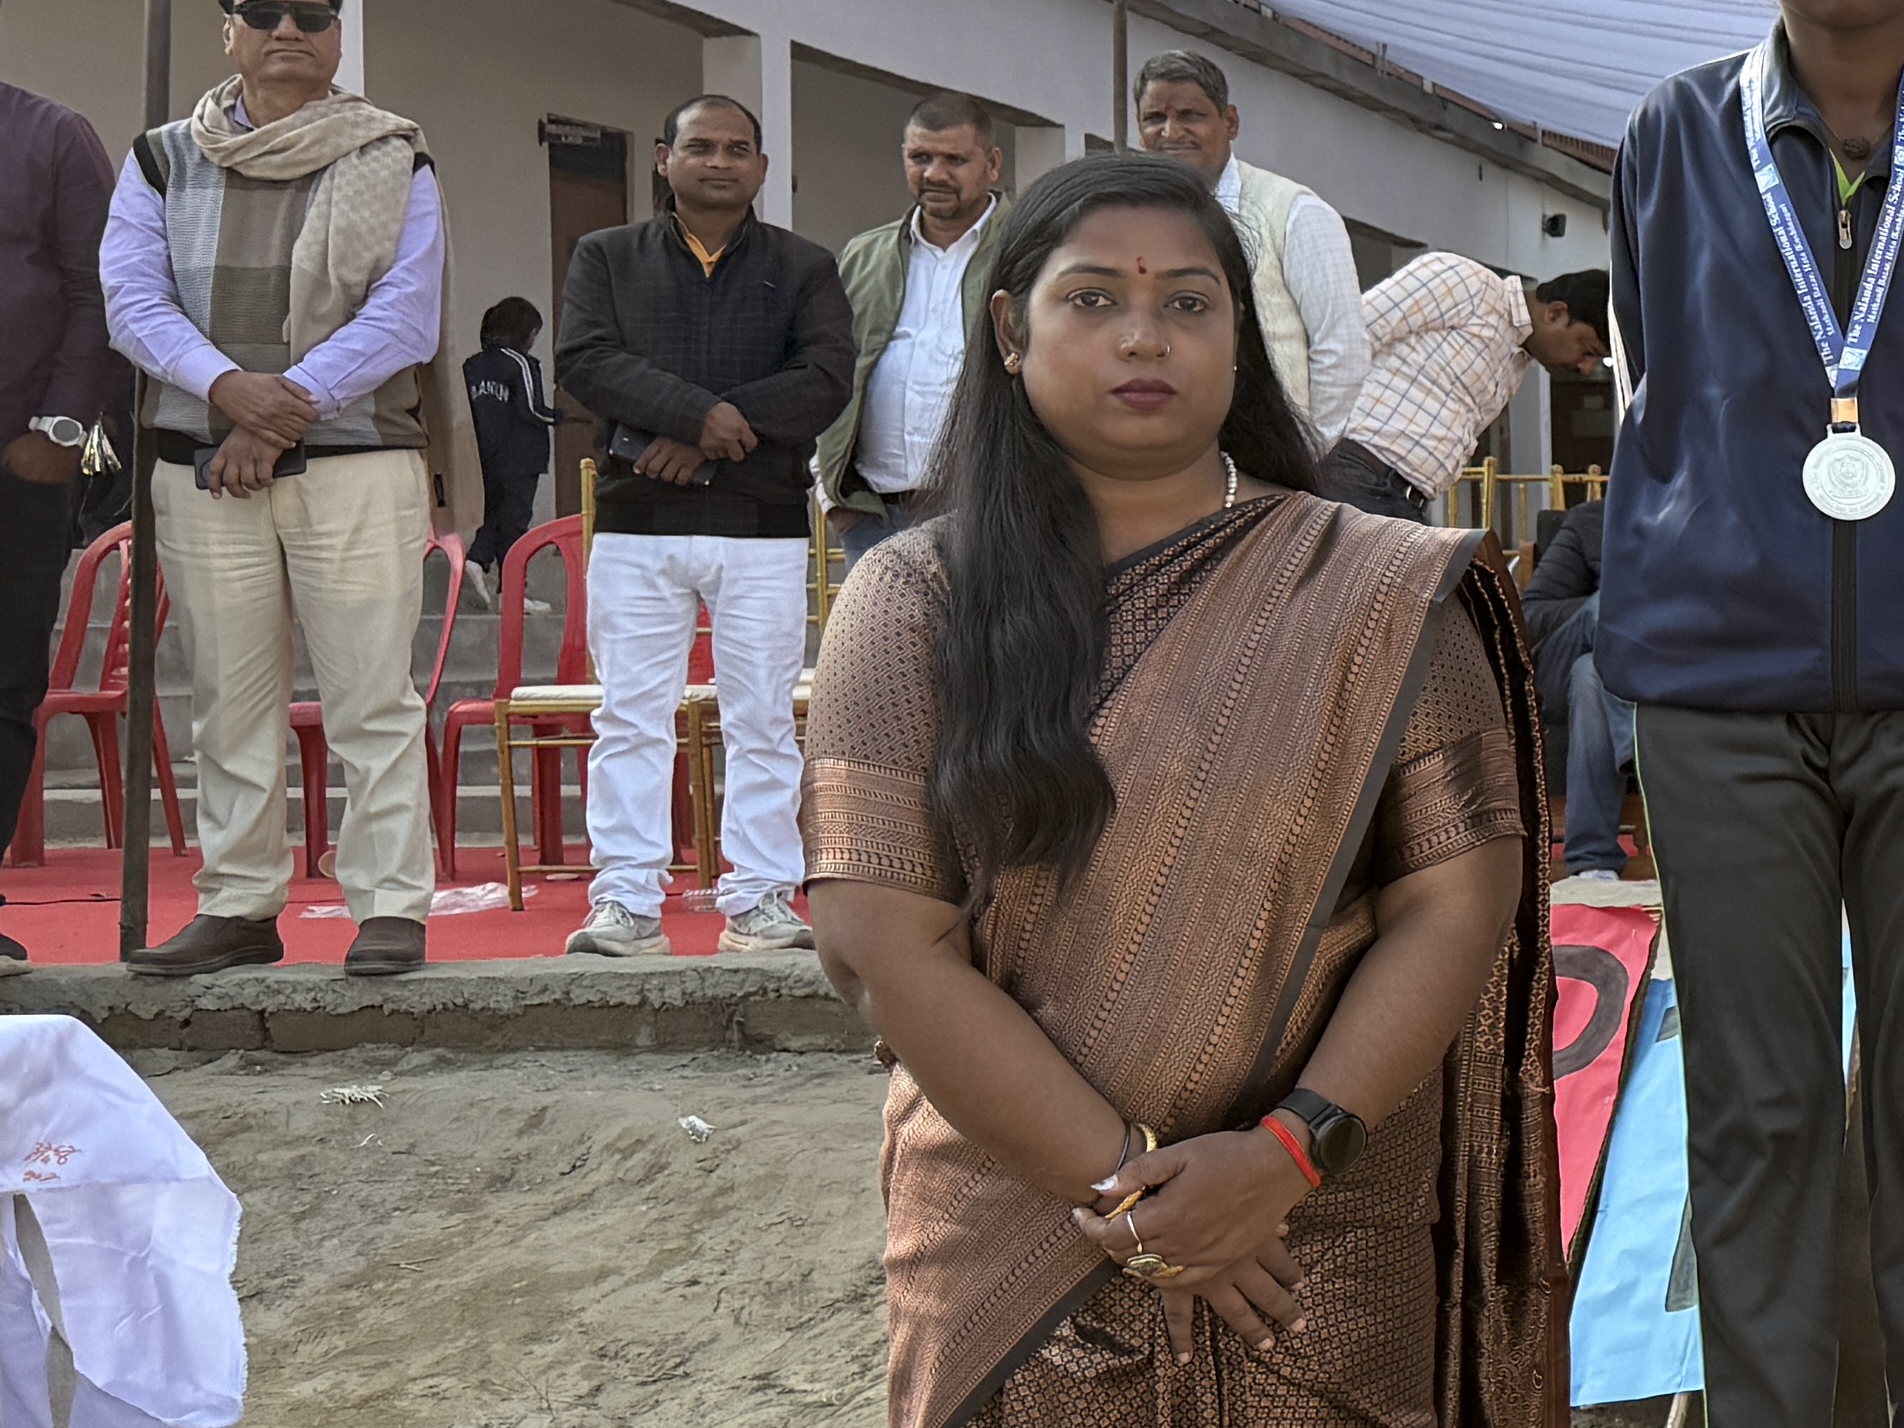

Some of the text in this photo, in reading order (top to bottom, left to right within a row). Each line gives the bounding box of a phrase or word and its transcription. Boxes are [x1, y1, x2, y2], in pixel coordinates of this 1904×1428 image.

[1865, 204, 1896, 275] International
[1759, 191, 1835, 363] The Nalanda International School
[1852, 275, 1876, 322] Nalanda
[1846, 322, 1862, 345] The
